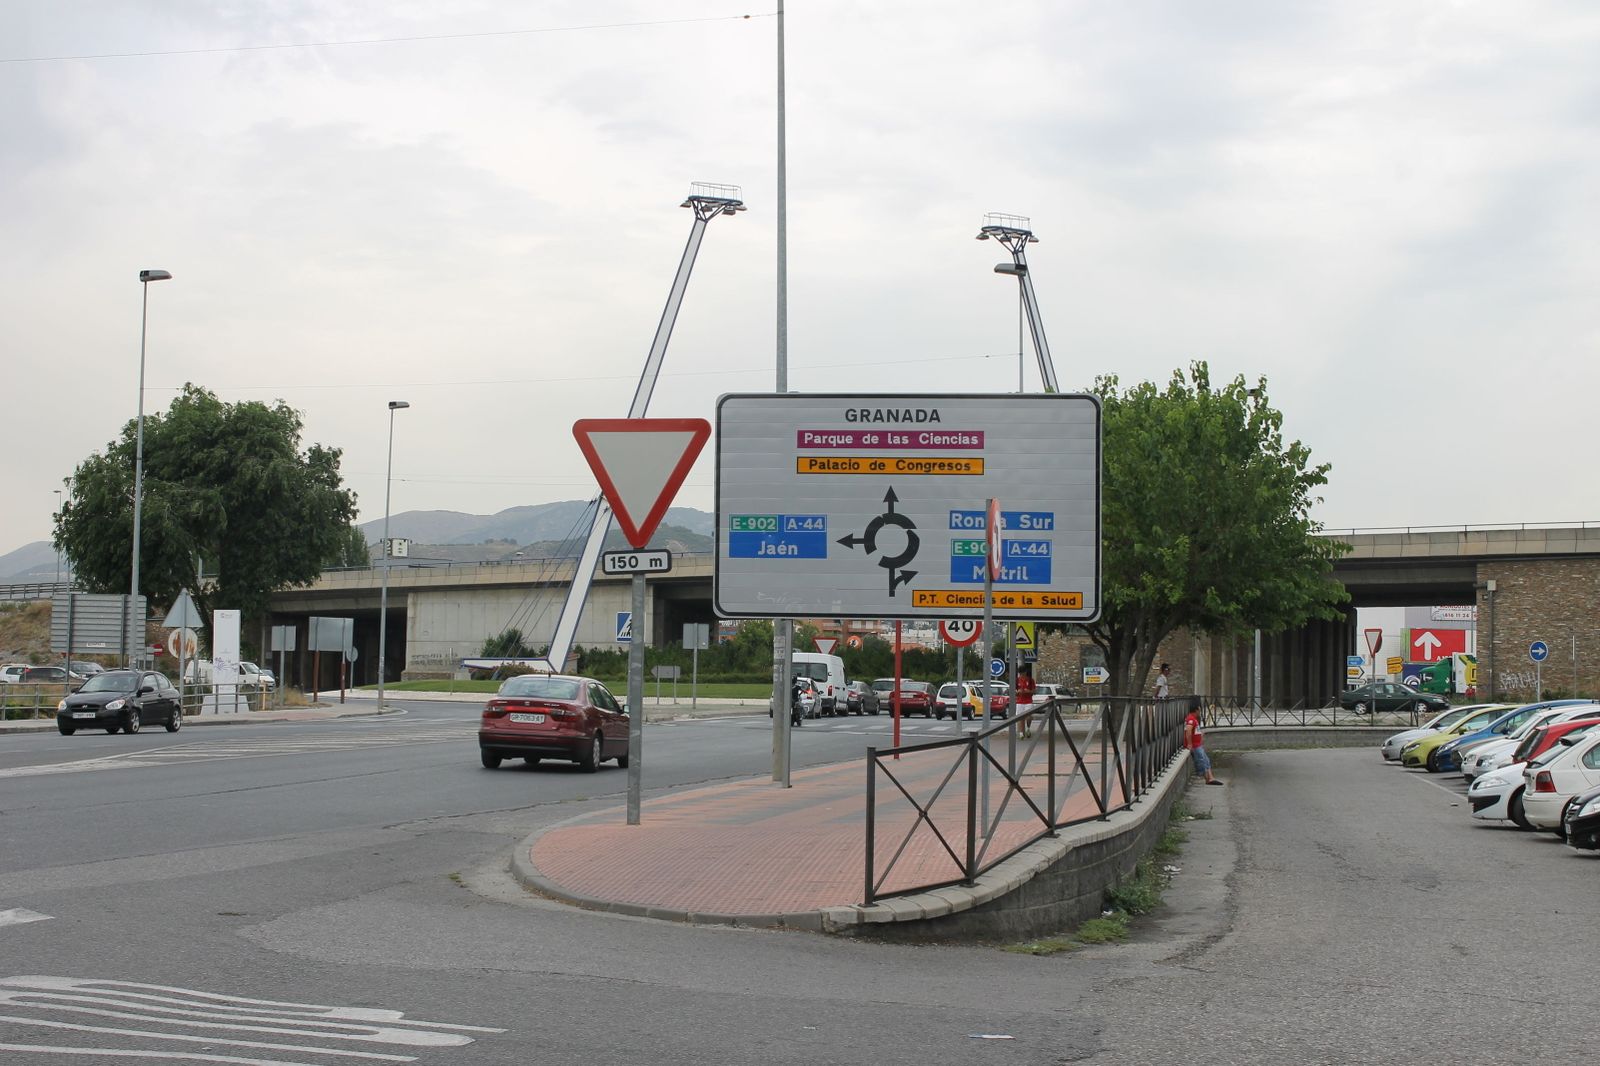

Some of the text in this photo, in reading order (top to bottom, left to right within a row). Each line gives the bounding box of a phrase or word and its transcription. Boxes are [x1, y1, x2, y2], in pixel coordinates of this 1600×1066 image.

[845, 408, 941, 423] GRANADA
[804, 433, 979, 447] Parque de las Ciencias
[809, 459, 971, 472] Palacio de Congresos
[732, 518, 824, 530] E-902 A-44
[951, 513, 1052, 529] Rona Sur
[758, 540, 798, 555] Jaén
[954, 542, 1048, 555] E-90 A-44
[610, 555, 663, 570] 150 m
[973, 565, 1028, 580] Mtril
[919, 594, 1076, 606] P.T. Ciencis de la Salud
[948, 621, 974, 633] 40
